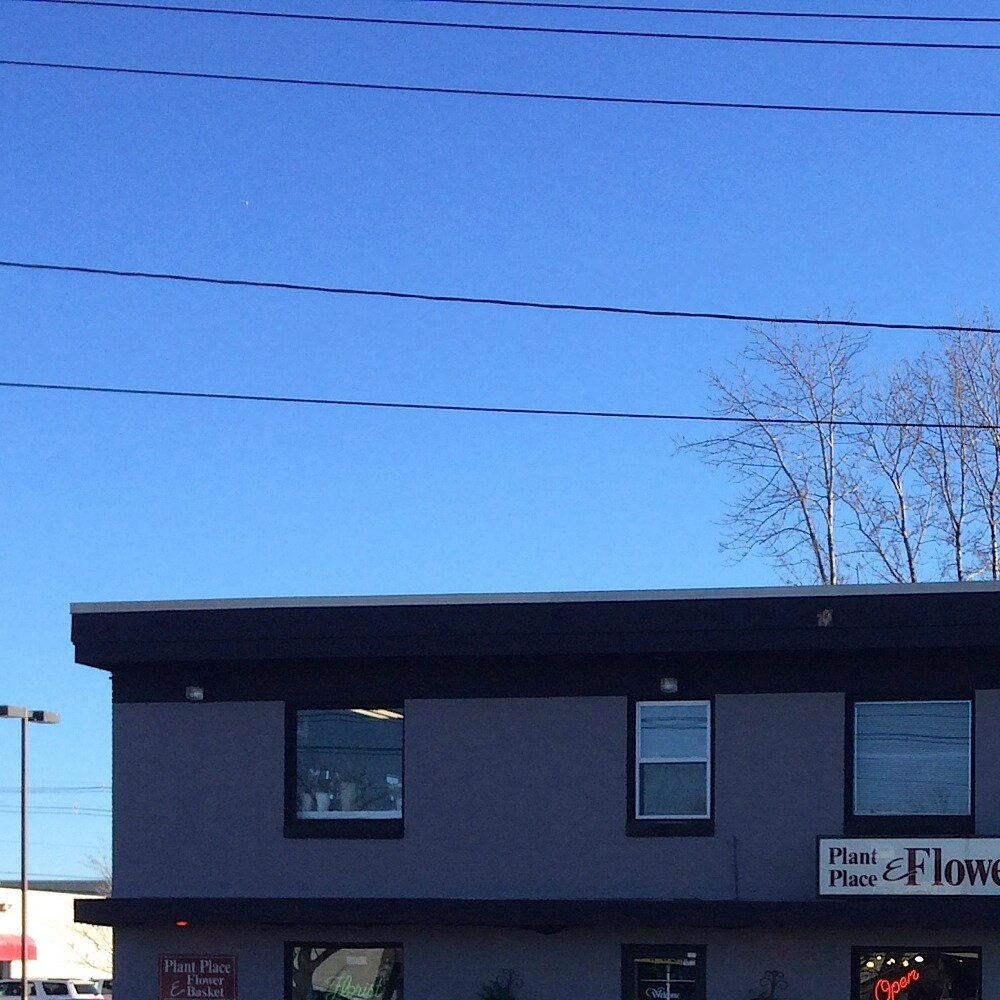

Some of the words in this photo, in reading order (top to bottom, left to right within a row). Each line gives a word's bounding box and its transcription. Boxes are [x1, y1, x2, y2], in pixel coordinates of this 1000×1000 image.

[828, 847, 877, 865] Plant
[828, 869, 878, 887] Place
[164, 959, 195, 973] Plant
[200, 960, 231, 974] Place
[187, 974, 225, 985] Flower
[187, 986, 225, 998] Basket
